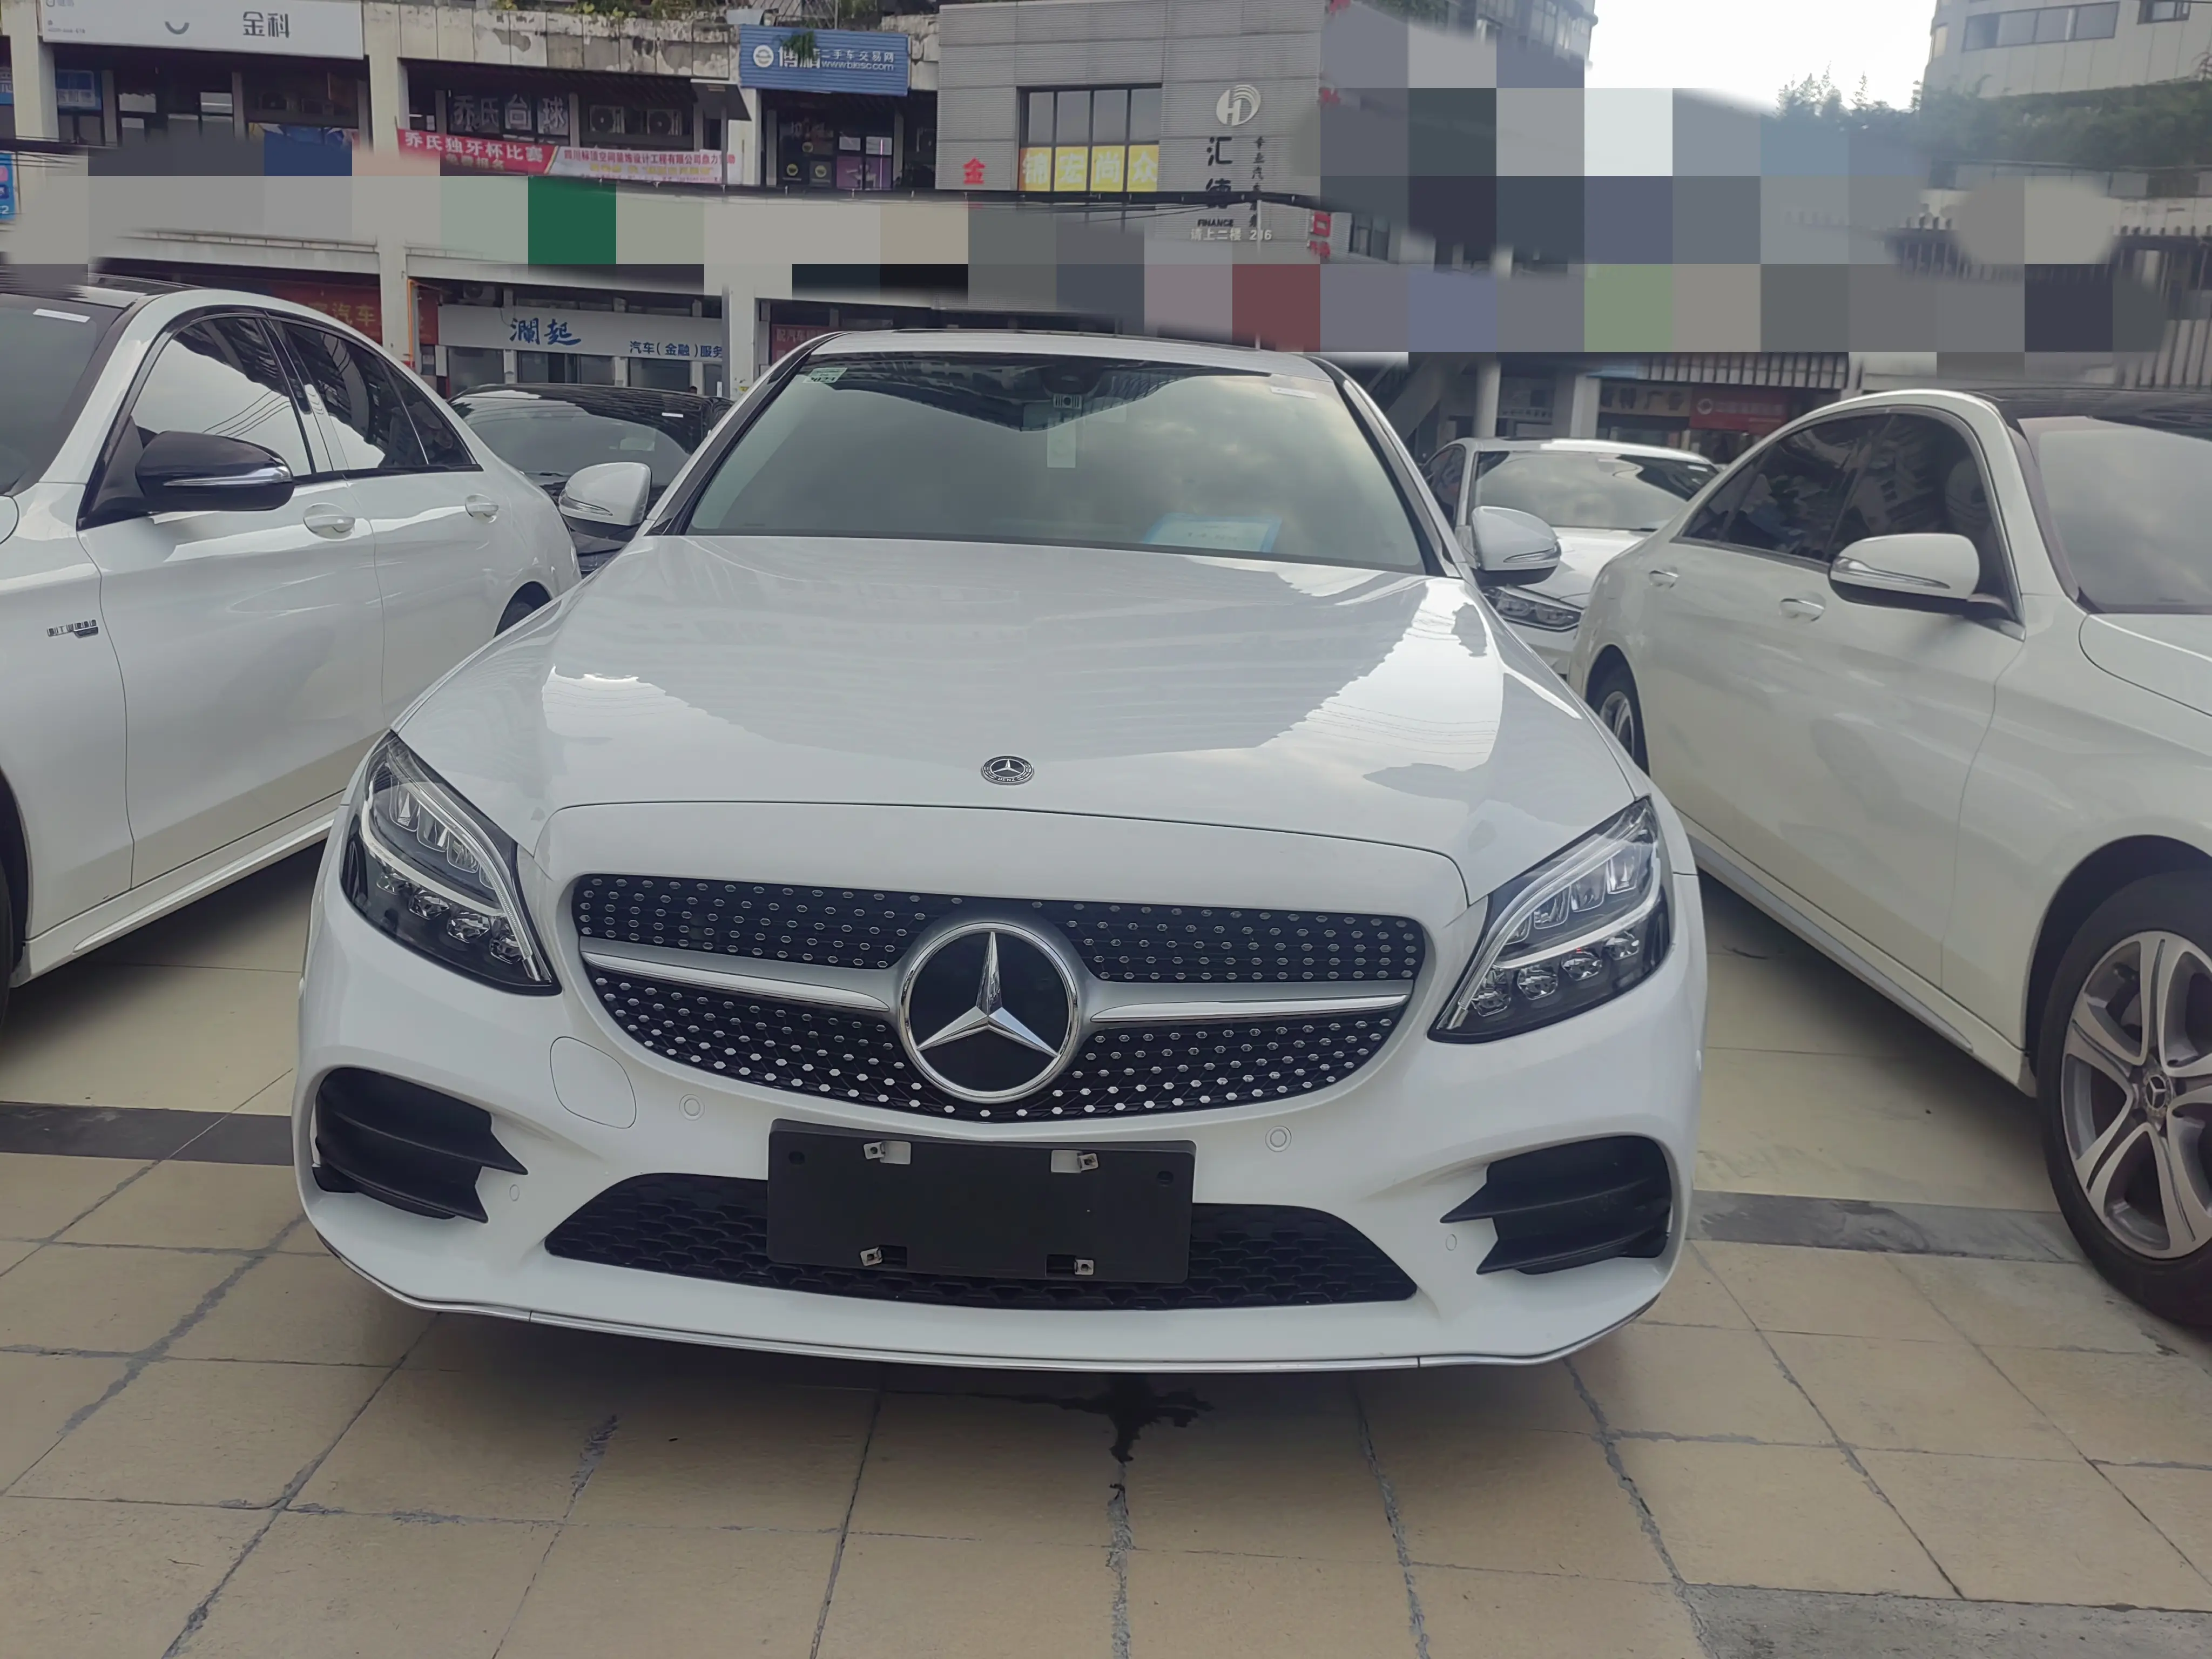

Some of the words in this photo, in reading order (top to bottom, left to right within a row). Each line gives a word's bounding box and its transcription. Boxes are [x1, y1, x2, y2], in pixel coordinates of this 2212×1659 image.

[242, 11, 290, 38] 金科
[821, 49, 894, 63] 二手车交易网
[453, 94, 566, 132] 乔氏台球
[405, 131, 543, 163] 乔氏独牙杯比赛
[962, 157, 986, 185] 金
[1197, 218, 1235, 227] FINANCE
